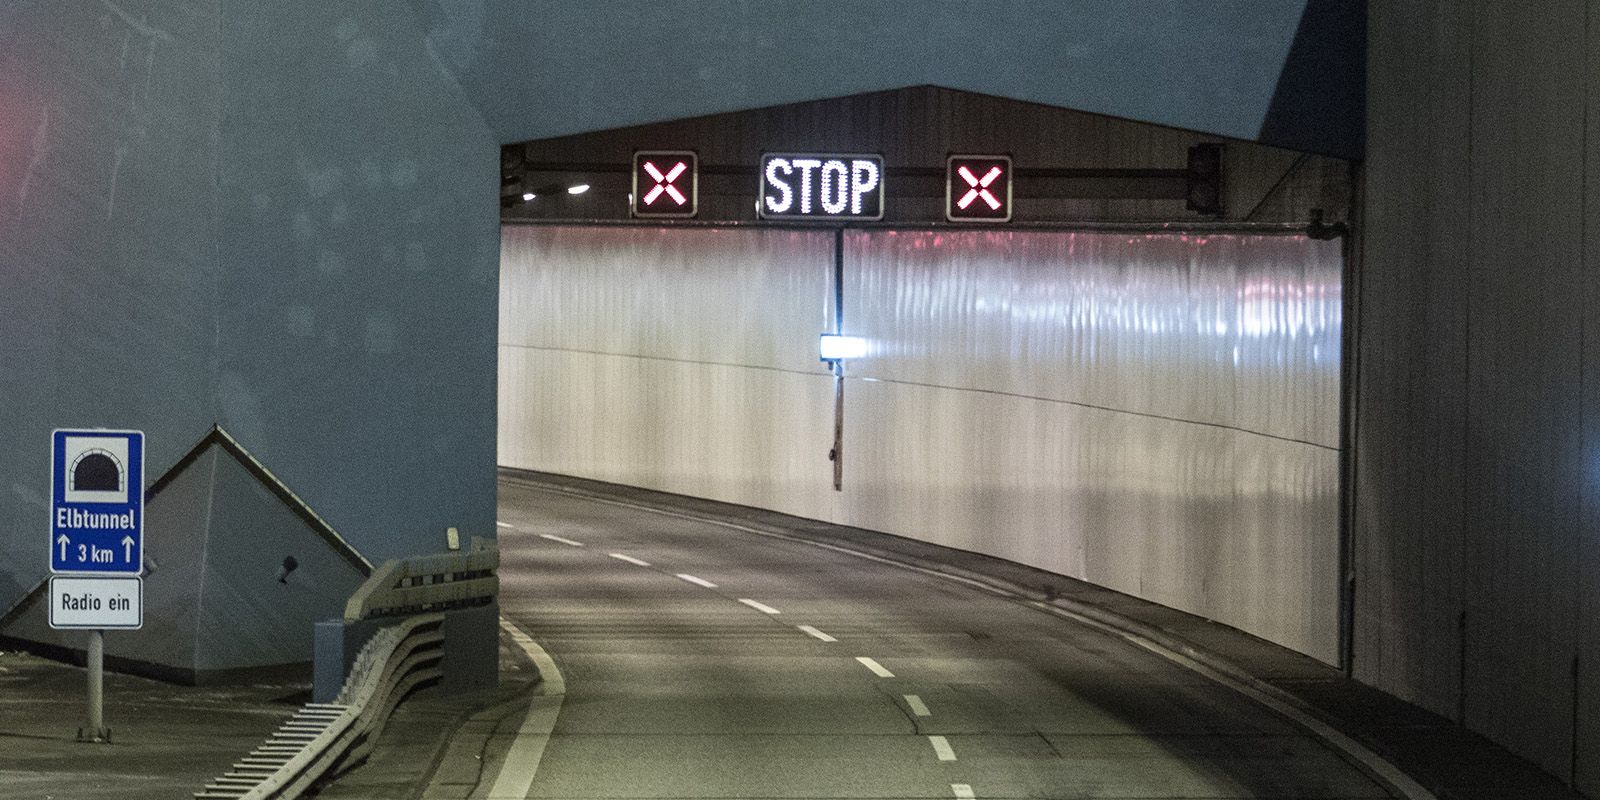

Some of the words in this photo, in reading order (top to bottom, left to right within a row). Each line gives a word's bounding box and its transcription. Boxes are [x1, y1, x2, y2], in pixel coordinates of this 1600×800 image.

[765, 158, 879, 214] STOP
[57, 508, 135, 529] Elbtunnel
[78, 544, 87, 562] 3
[91, 545, 113, 563] km
[62, 593, 101, 610] Radio
[109, 594, 130, 610] ein
